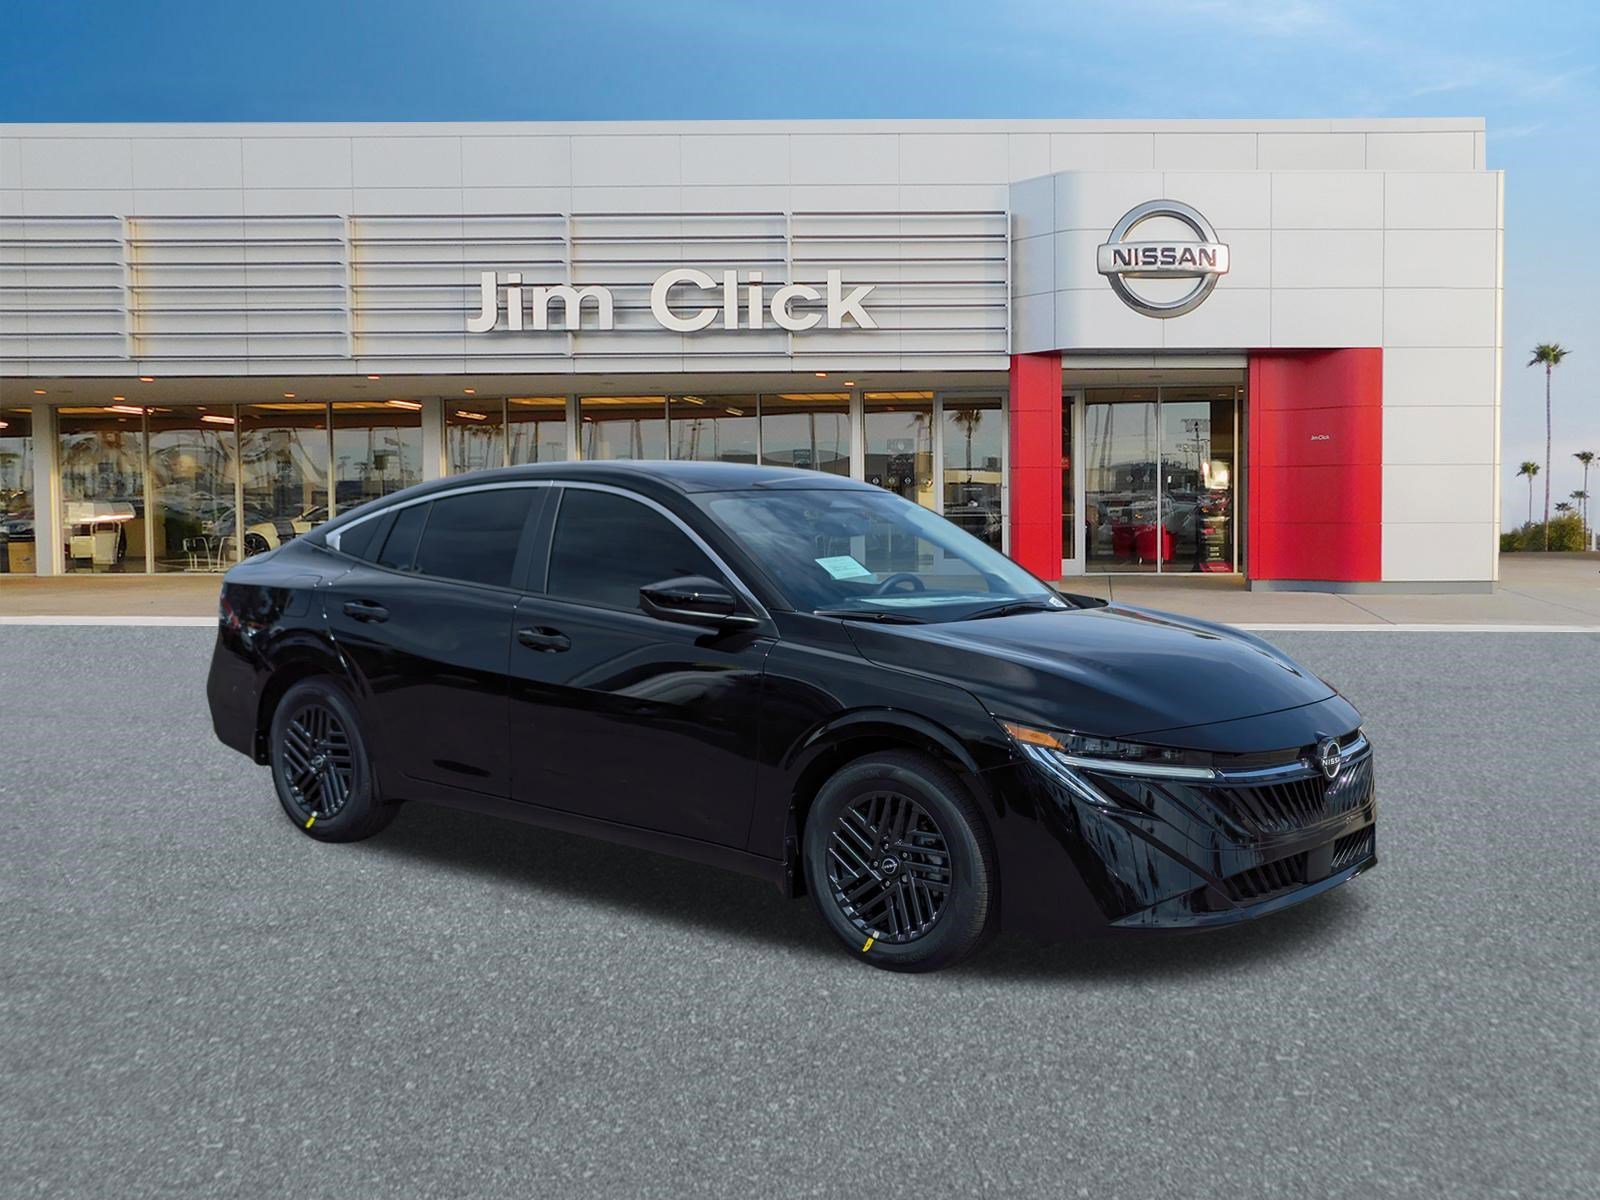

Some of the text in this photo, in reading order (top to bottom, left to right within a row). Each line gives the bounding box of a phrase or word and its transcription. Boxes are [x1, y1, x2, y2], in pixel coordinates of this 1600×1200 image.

[1112, 247, 1217, 267] NISSAN
[467, 268, 879, 333] Jim Click
